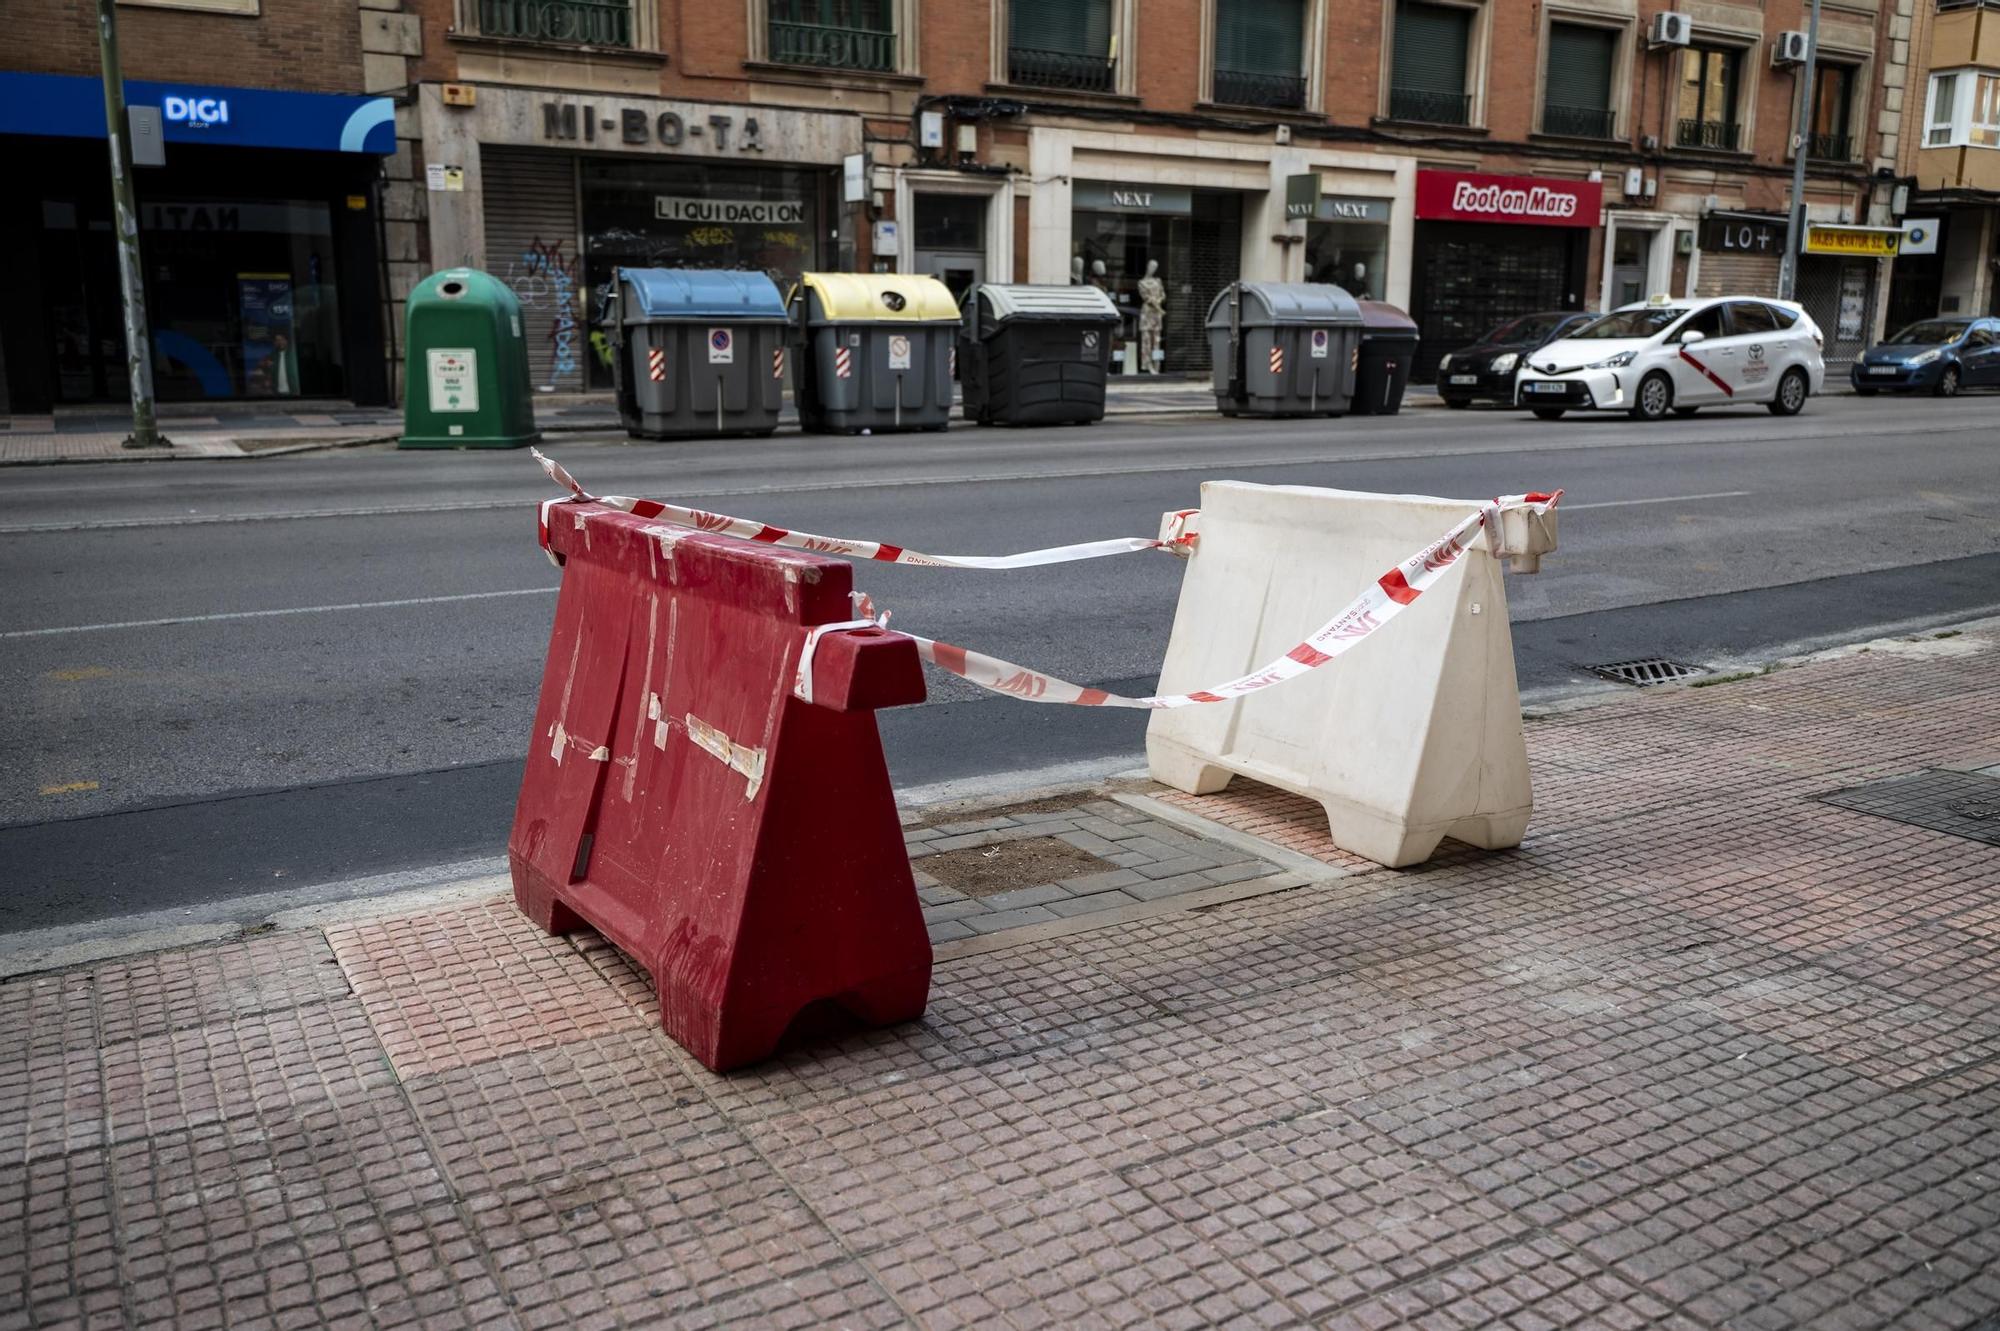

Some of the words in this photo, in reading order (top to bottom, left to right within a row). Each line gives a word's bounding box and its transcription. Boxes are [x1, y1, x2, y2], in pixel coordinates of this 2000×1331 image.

[165, 97, 228, 123] DIGI
[544, 102, 764, 153] MI-BO-TA
[1112, 190, 1154, 207] NEXT
[1287, 203, 1313, 215] NEXT
[1334, 202, 1369, 218] NEXT
[1453, 181, 1500, 212] Foot
[1499, 190, 1527, 213] on
[1526, 187, 1577, 217] Mars
[657, 199, 804, 222] LIQUIDACION
